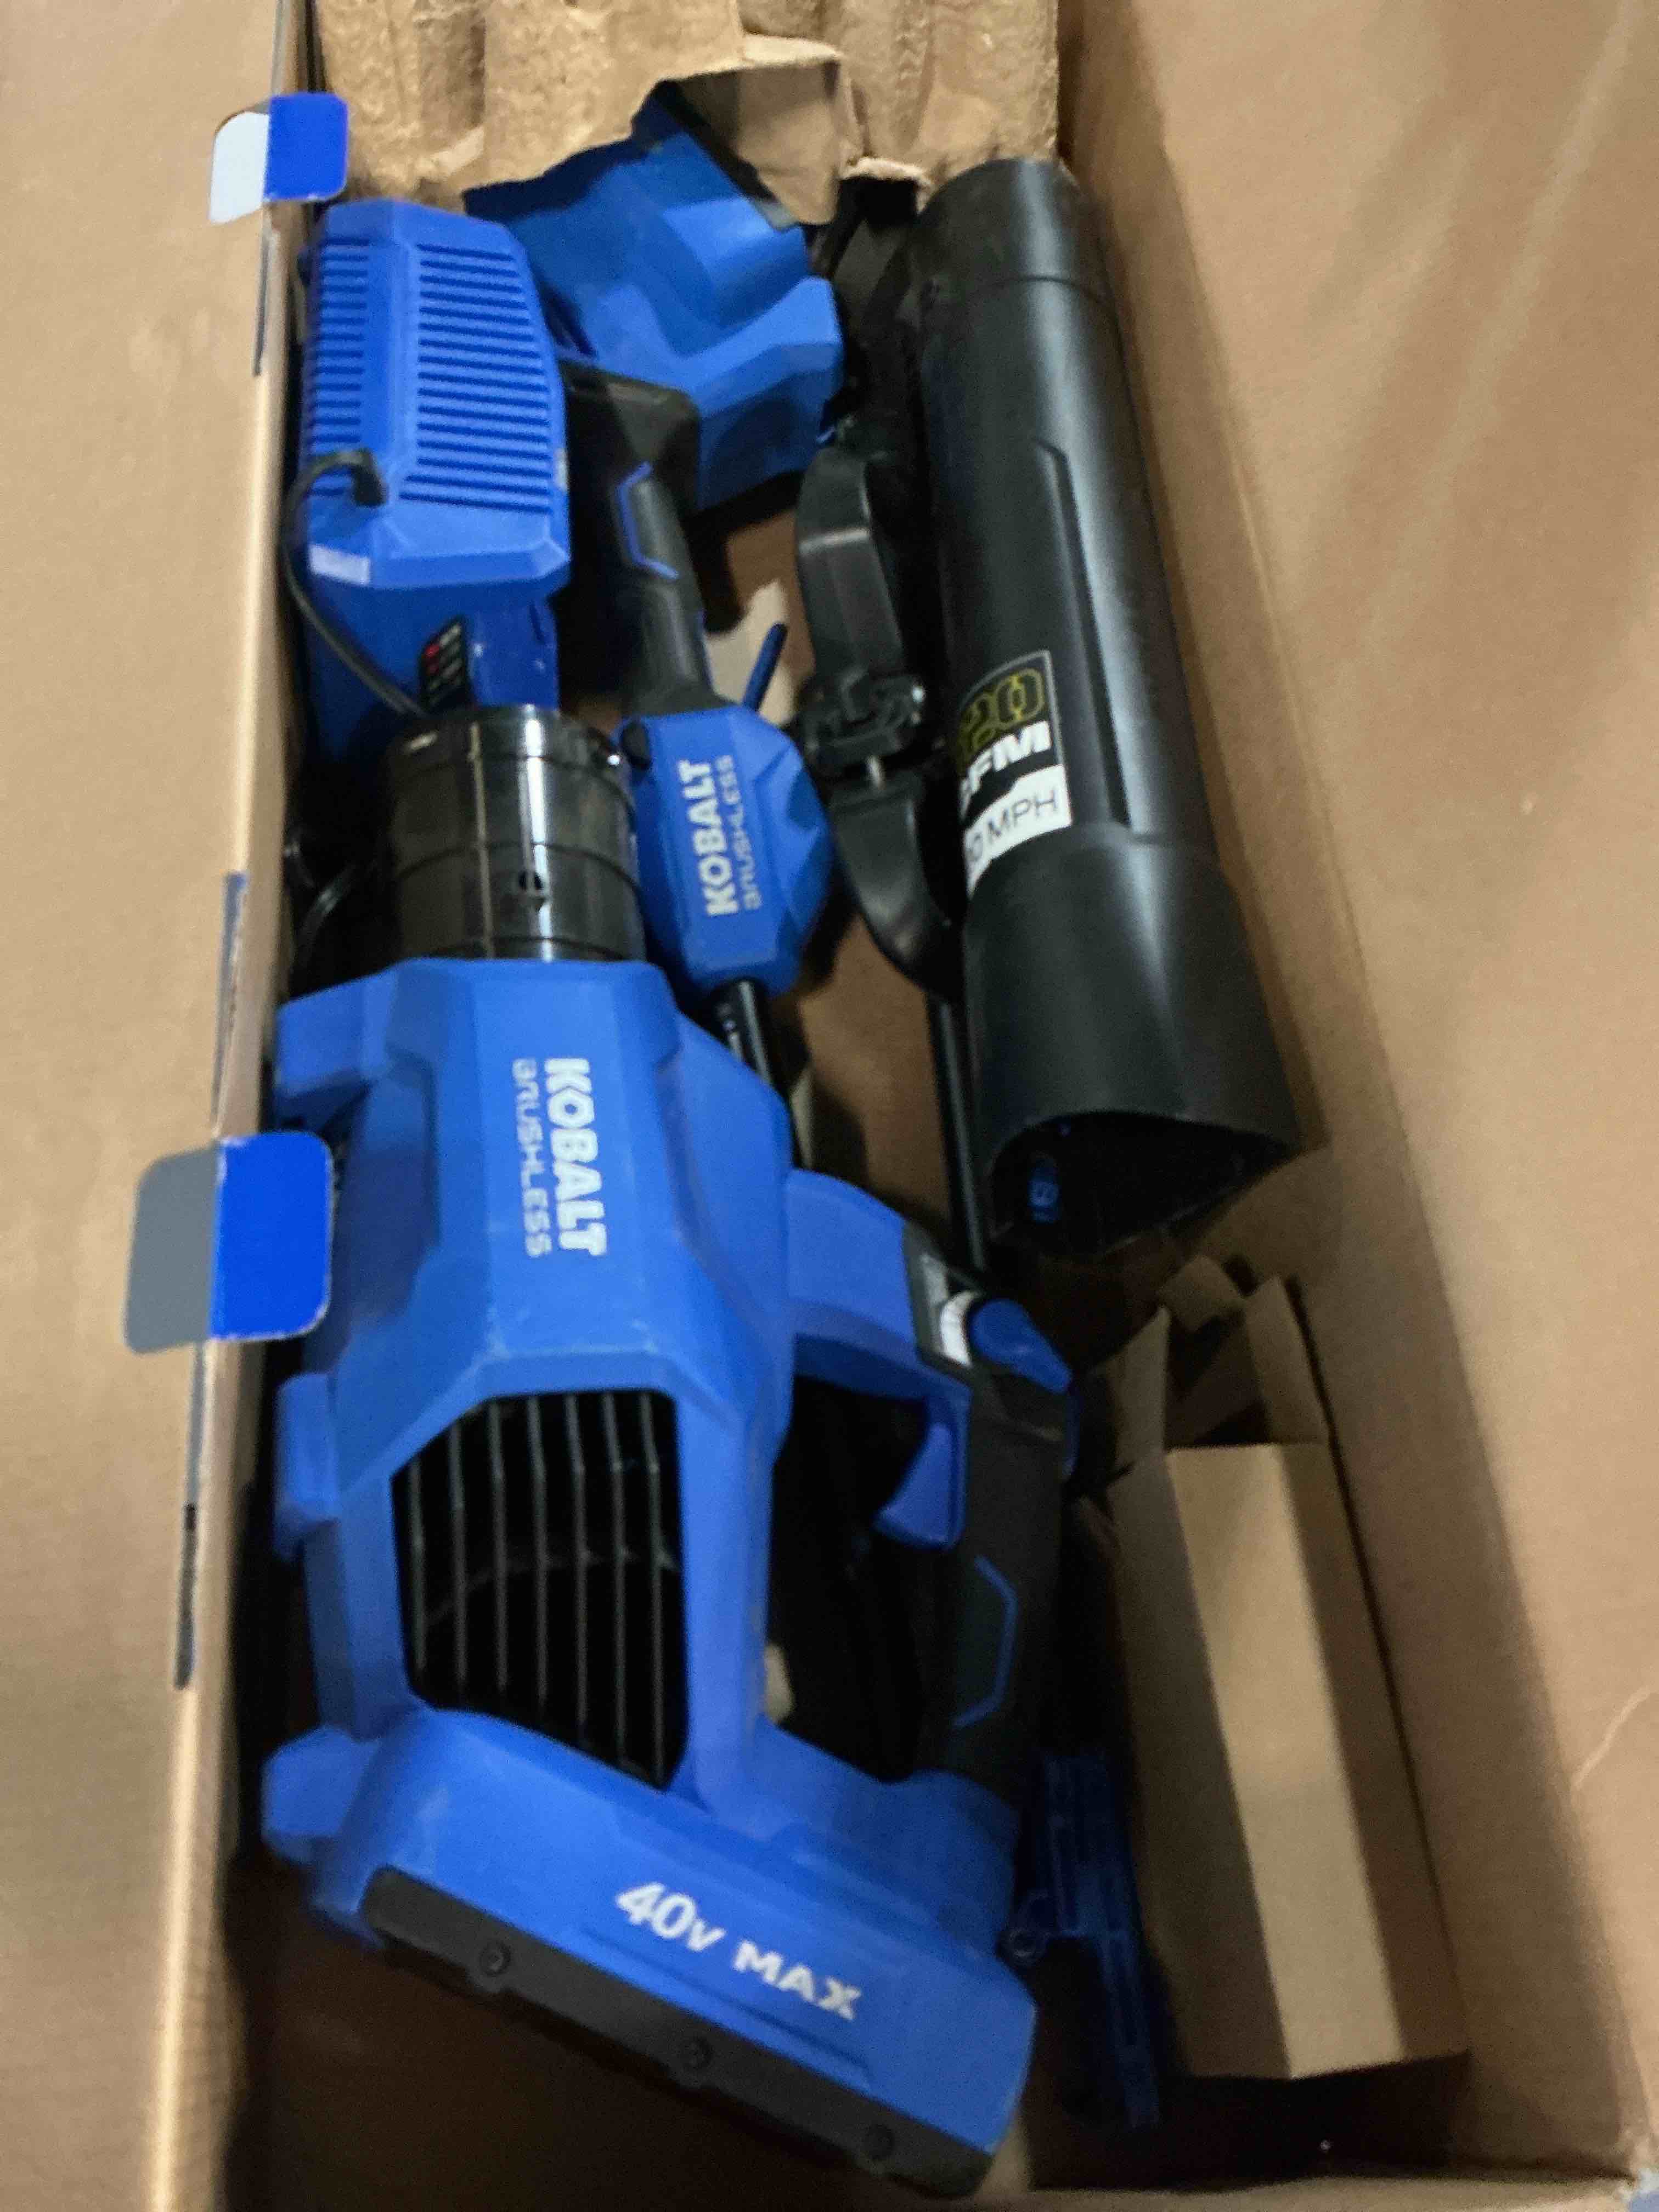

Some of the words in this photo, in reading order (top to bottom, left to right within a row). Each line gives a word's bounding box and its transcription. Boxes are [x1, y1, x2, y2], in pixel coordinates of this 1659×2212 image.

[957, 668, 1045, 758] 20
[678, 759, 739, 916] KOBALT
[987, 789, 1058, 845] MPH
[512, 1058, 552, 1257] BRUSHLESS
[544, 1058, 607, 1256] KOBALT
[732, 1939, 861, 2021] MAX
